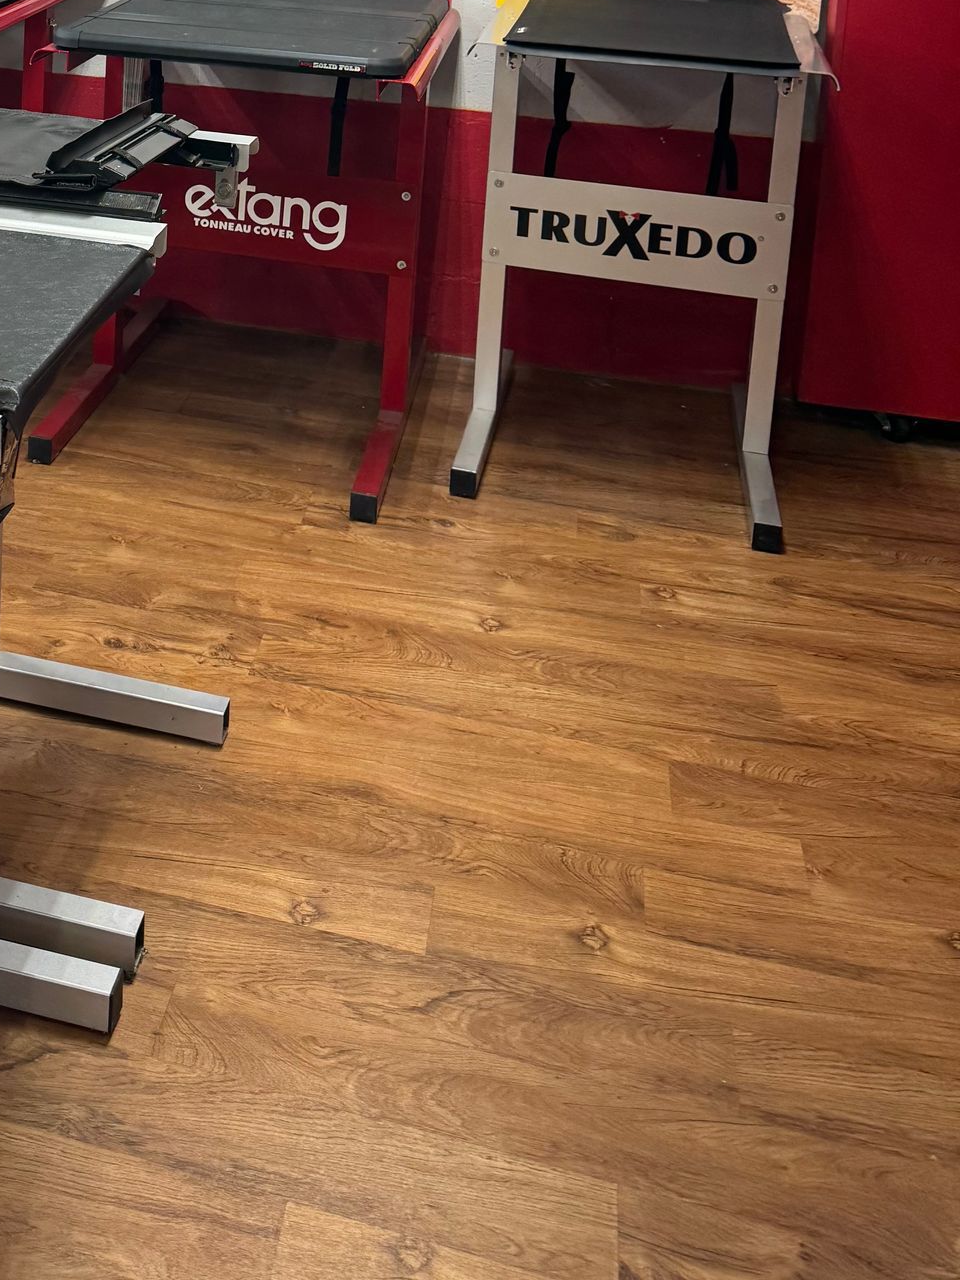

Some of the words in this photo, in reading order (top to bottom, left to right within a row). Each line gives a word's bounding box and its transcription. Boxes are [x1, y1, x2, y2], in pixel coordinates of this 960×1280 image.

[313, 62, 337, 70] SOLID
[338, 64, 361, 72] FOLD
[193, 217, 252, 234] TONNEAU
[253, 225, 294, 240] COVER
[510, 205, 758, 265] TRUXEDO
